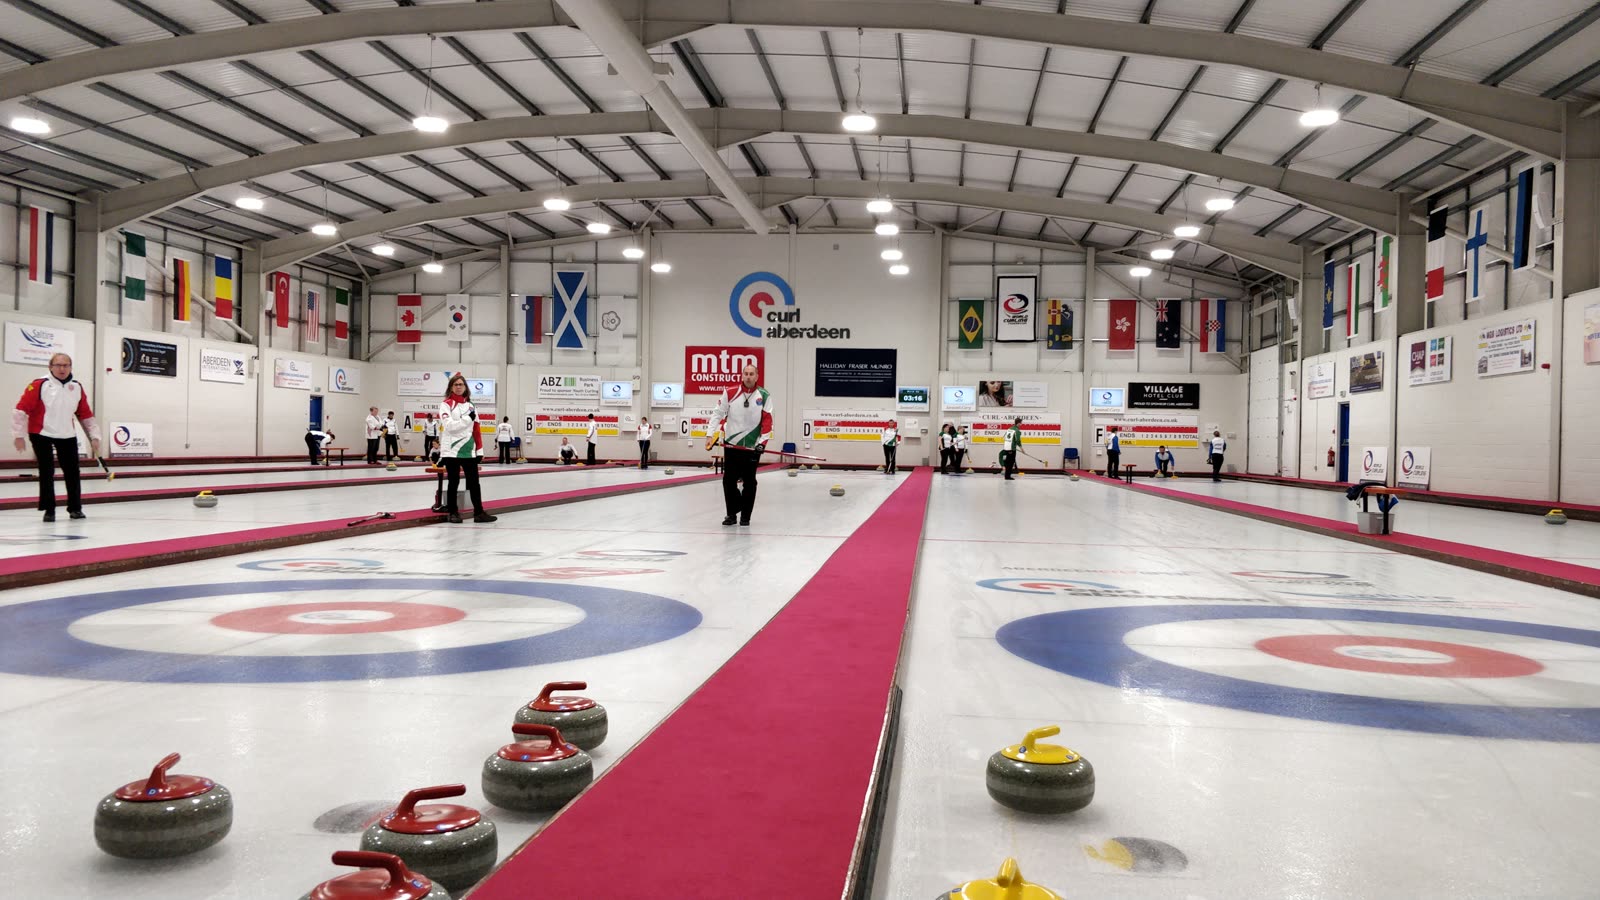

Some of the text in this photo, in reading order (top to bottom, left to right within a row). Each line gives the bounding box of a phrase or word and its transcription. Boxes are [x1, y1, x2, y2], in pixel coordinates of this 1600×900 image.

[766, 308, 800, 322] curl
[766, 324, 850, 339] aberdeen
[203, 355, 231, 366] ABERDEEN
[692, 350, 758, 373] mtm
[1412, 350, 1424, 362] CHAP
[540, 377, 562, 386] ABZ
[691, 374, 743, 382] CONSTRUCT
[404, 415, 412, 429] A
[526, 416, 533, 431] B
[682, 421, 688, 434] C
[804, 423, 810, 436] D
[1096, 428, 1103, 443] F
